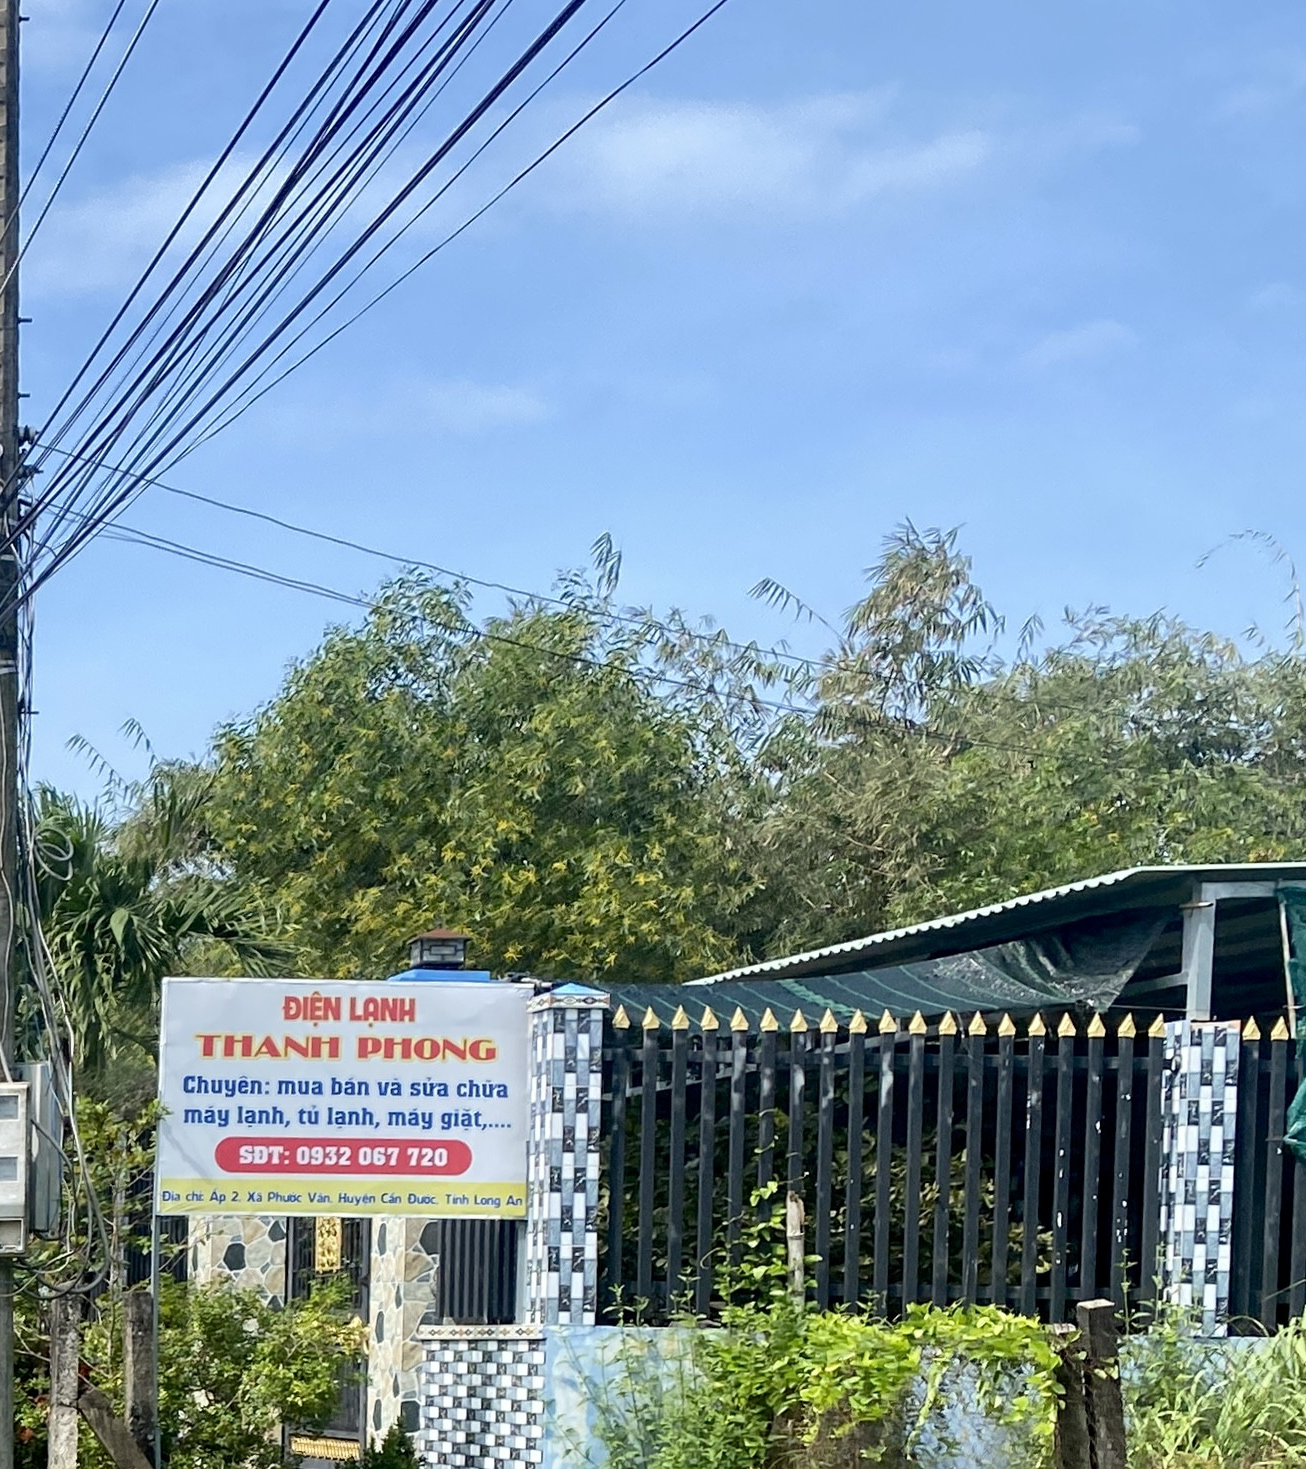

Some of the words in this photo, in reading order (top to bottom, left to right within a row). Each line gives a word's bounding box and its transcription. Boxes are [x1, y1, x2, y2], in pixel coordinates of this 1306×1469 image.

[282, 991, 341, 1027] ĐIỆN
[349, 996, 416, 1028] LẠNH
[195, 1034, 341, 1059] THANH
[357, 1036, 497, 1061] PHONG
[182, 1075, 271, 1098] Chuyên:
[277, 1079, 324, 1096] mua
[330, 1077, 370, 1097] bán
[377, 1078, 403, 1097] và
[410, 1077, 449, 1098] sửa
[456, 1079, 509, 1099] chữa
[183, 1105, 230, 1128] máy
[237, 1106, 291, 1128] lạnh,
[298, 1105, 320, 1125] tủ
[327, 1107, 381, 1129] lạnh,
[388, 1108, 433, 1131] máy
[238, 1145, 291, 1165] SĐT:
[295, 1146, 352, 1166] 0932
[358, 1146, 400, 1167] 067
[407, 1147, 449, 1167] 720
[473, 1194, 501, 1208] Long
[506, 1195, 524, 1207] An
